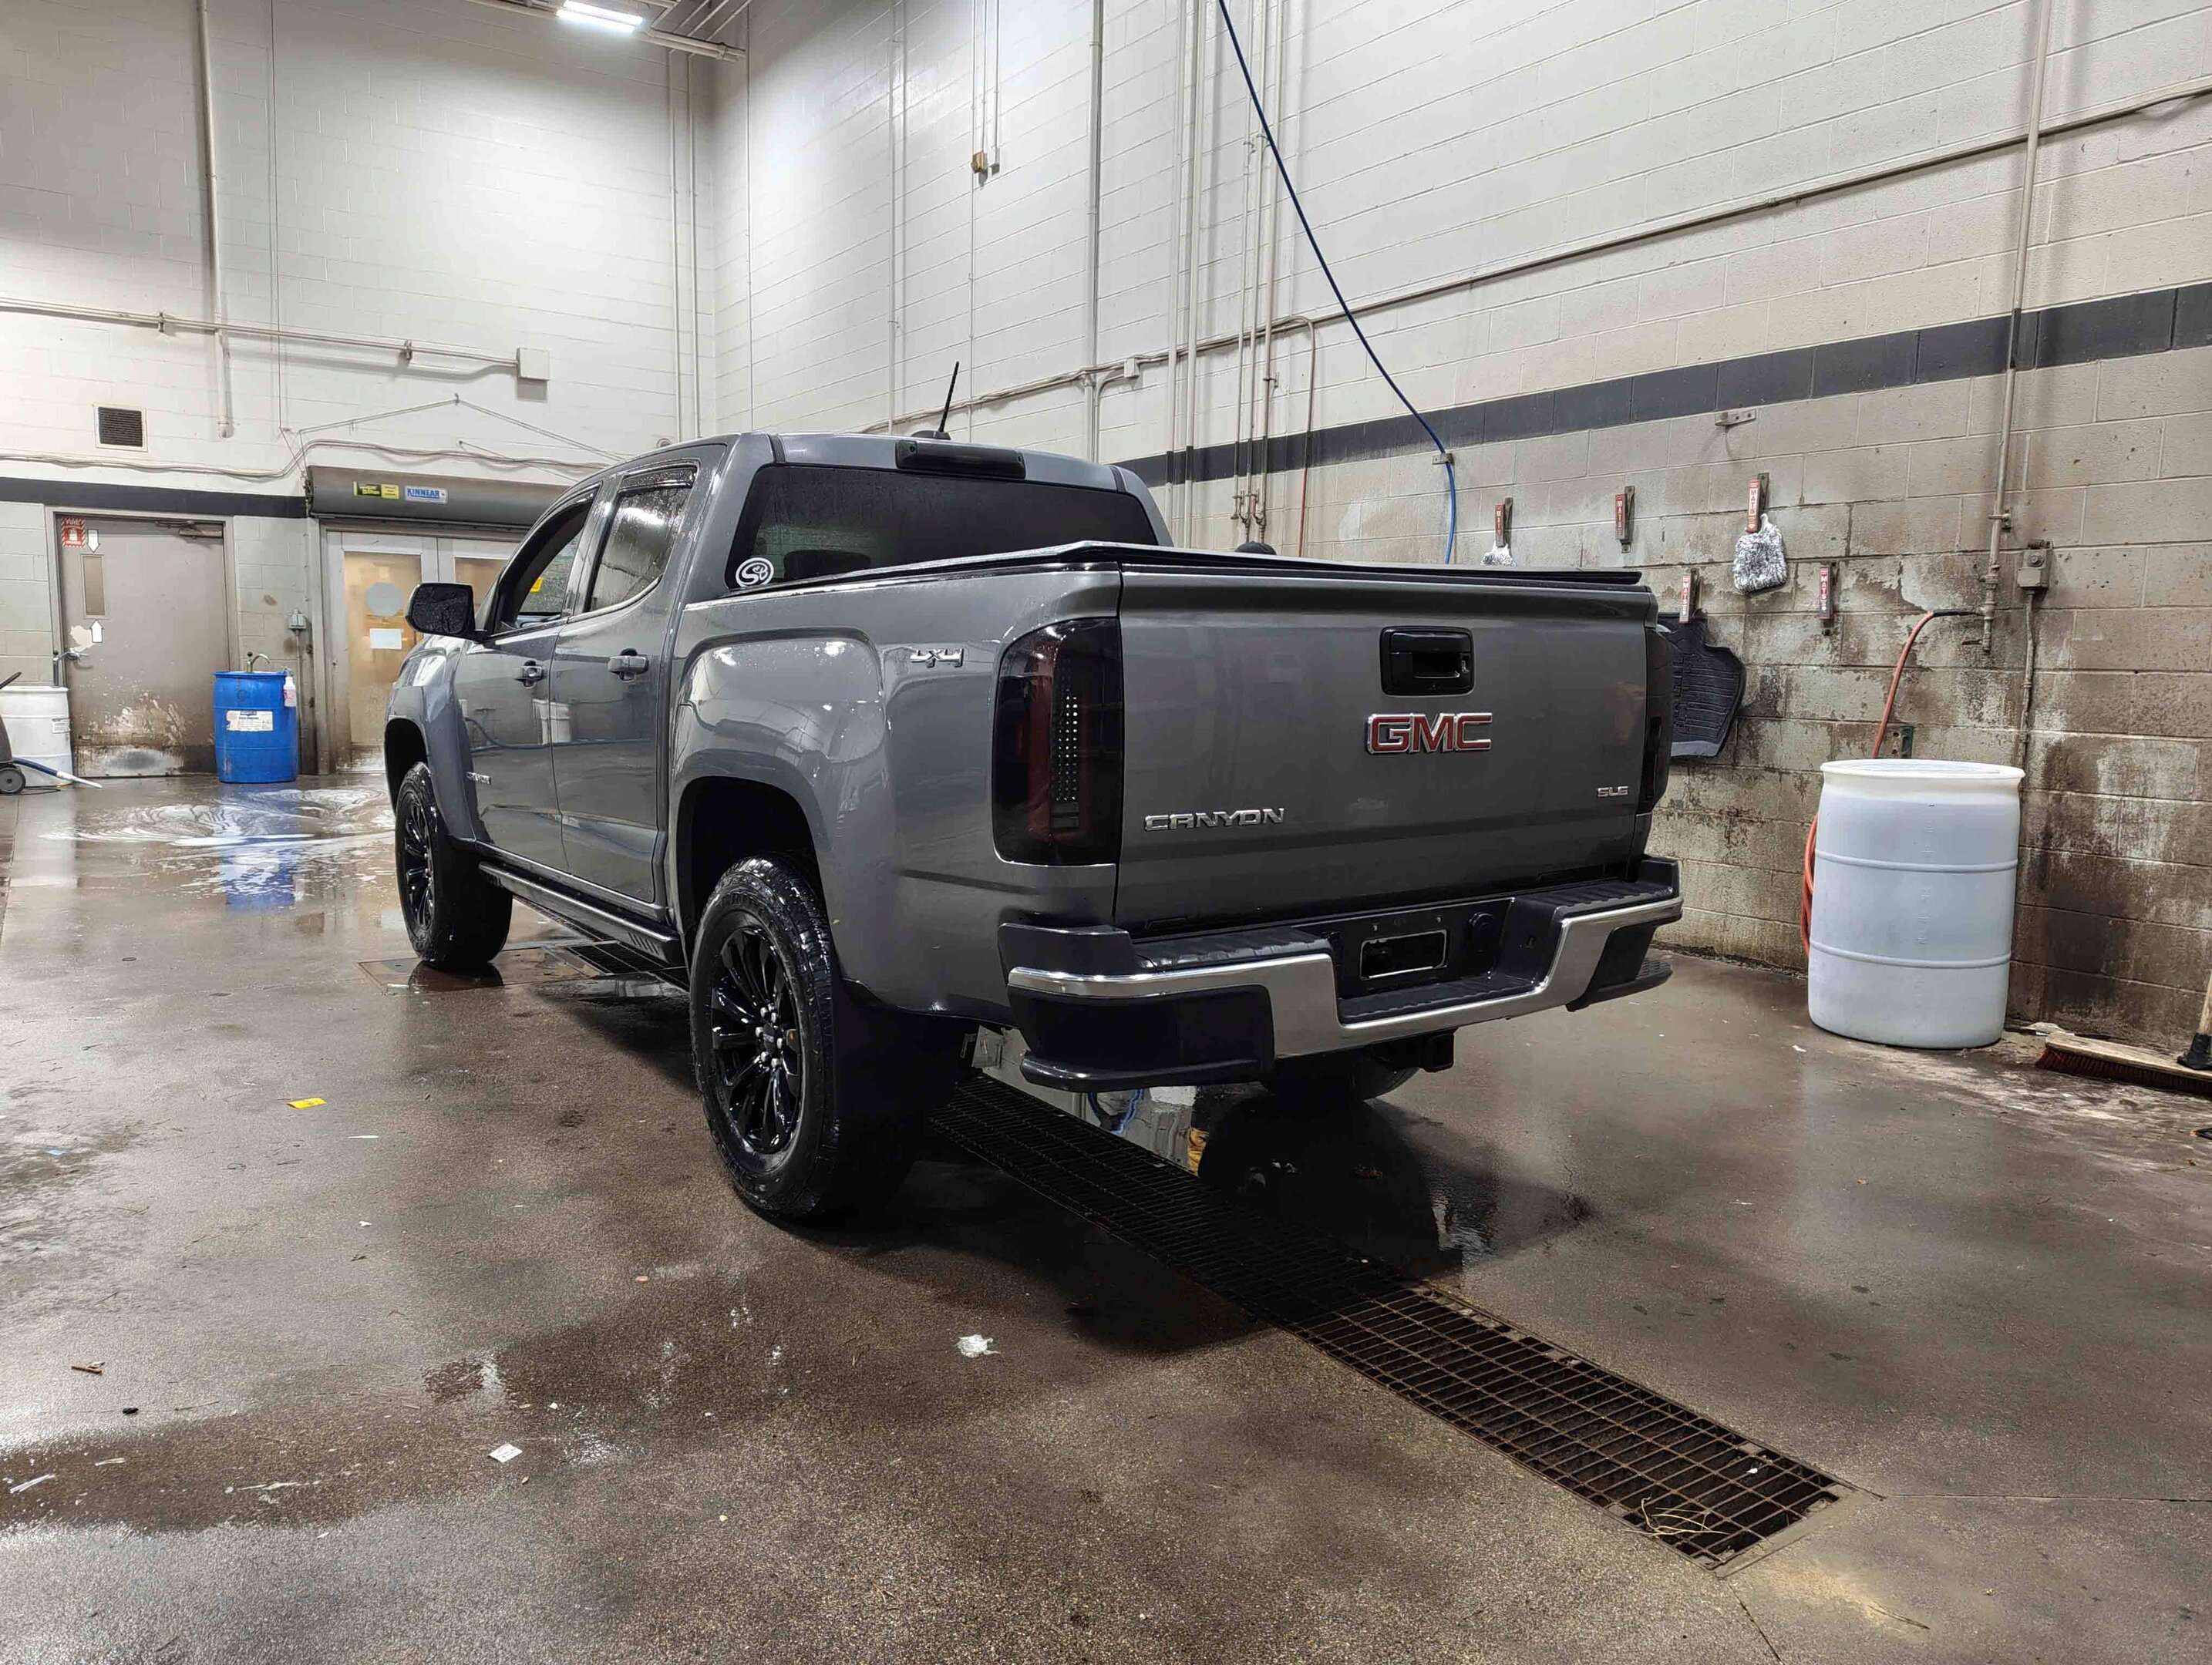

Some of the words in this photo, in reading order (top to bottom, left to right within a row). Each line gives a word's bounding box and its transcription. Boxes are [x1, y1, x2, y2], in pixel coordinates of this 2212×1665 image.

[407, 488, 439, 498] KINNEAR
[1367, 712, 1493, 755] GMC
[1144, 808, 1285, 832] CANYON
